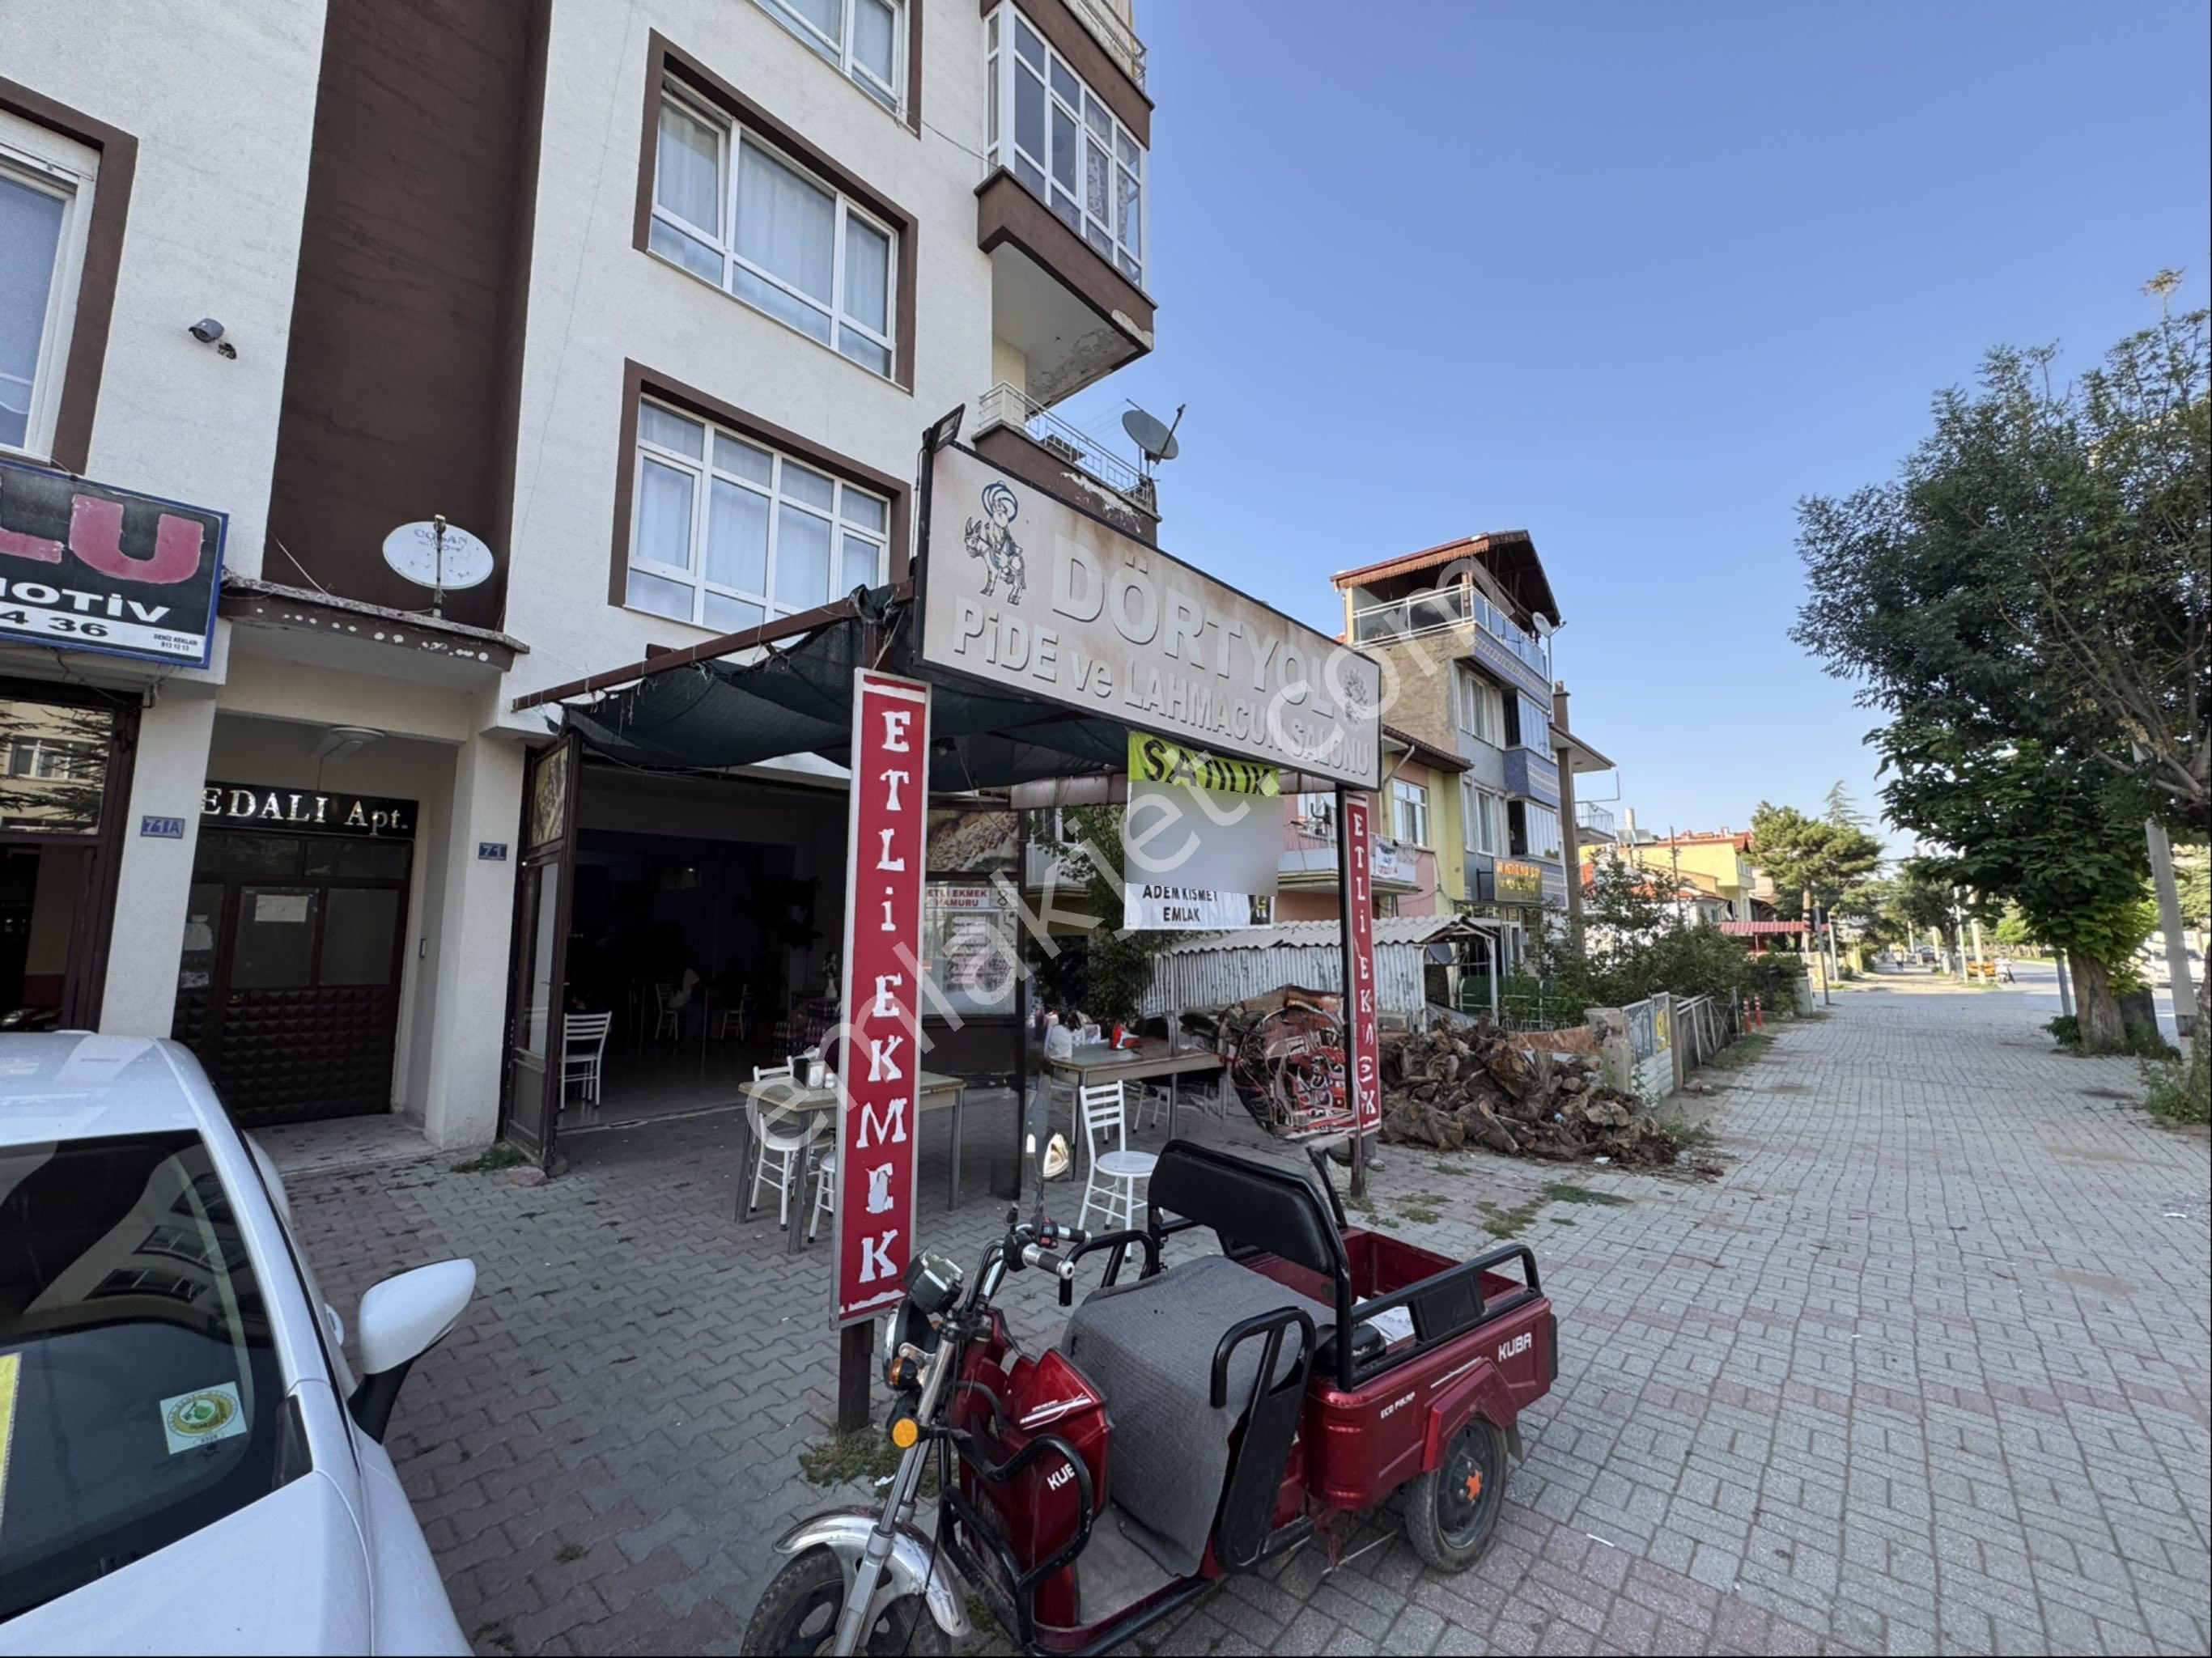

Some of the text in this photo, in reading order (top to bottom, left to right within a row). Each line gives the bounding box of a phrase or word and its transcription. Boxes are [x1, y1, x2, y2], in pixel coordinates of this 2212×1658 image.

[0, 577, 171, 623] OTİV
[49, 617, 108, 637] 36
[1052, 533, 1335, 719] DÖRTYOL
[1070, 650, 1114, 698] ve
[1124, 657, 1284, 752] LAHMACUN
[1292, 718, 1370, 776] SALONU
[145, 819, 180, 834] 71A
[344, 799, 409, 836] Apt.
[483, 846, 501, 857] 71
[953, 889, 987, 898] EKMEK
[1143, 884, 1217, 902] ADEM KISMET
[1163, 906, 1200, 922] EMLAK
[1497, 1331, 1533, 1363] KUBA
